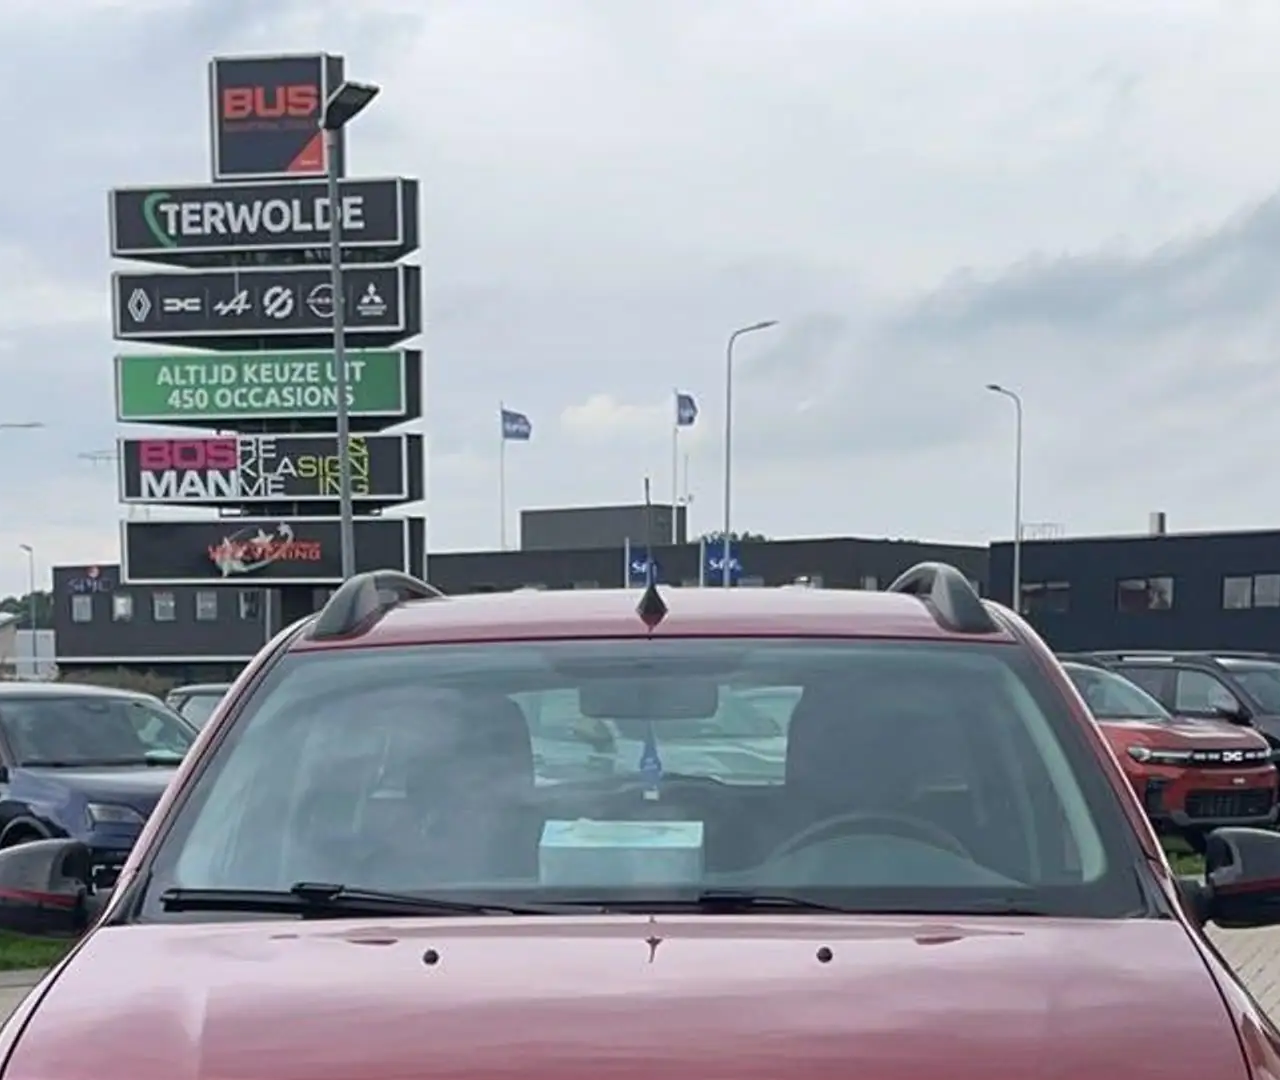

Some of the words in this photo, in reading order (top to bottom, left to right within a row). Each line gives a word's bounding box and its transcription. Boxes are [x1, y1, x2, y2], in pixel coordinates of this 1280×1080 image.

[224, 84, 318, 118] BUS
[159, 196, 365, 236] TERWOLDE
[157, 364, 237, 386] ALTIJD
[243, 362, 320, 384] KEUZE
[326, 361, 366, 382] UIT
[167, 388, 209, 410] 450
[214, 385, 355, 409] OCCASIONS
[140, 440, 237, 469] BOS
[140, 469, 239, 498] MAN
